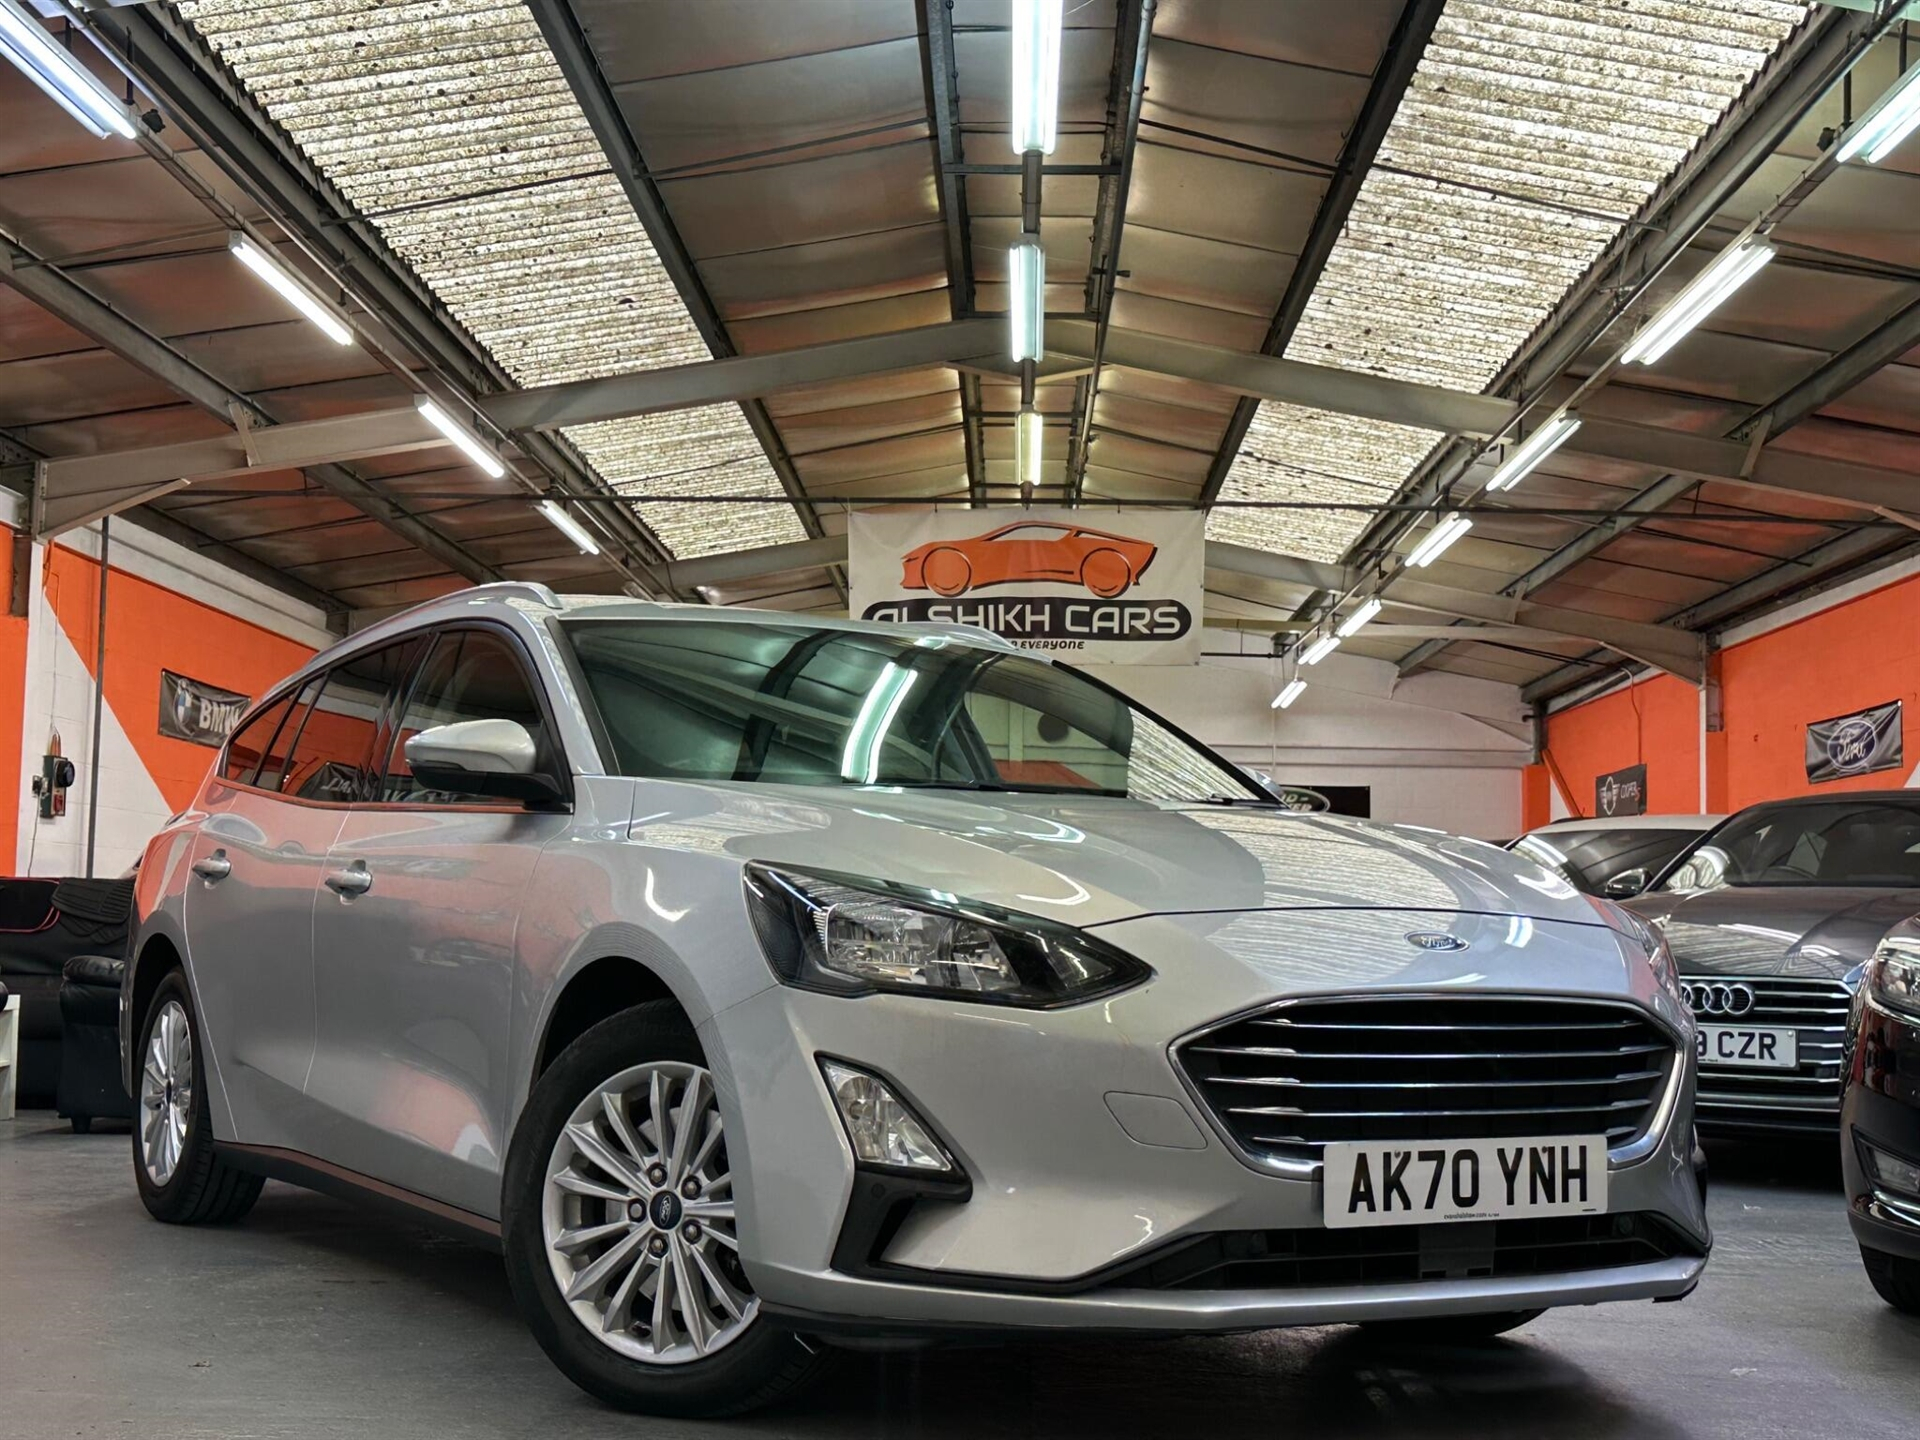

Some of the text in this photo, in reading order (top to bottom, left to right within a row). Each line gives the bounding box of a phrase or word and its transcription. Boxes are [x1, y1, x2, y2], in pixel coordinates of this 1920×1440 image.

[928, 604, 1050, 632] SHIKH
[1065, 606, 1181, 634] CARS
[1021, 640, 1085, 650] EVERYONE
[199, 698, 241, 735] BMW
[1718, 1031, 1777, 1060] CZR
[1348, 1145, 1588, 1213] AK70 YNH
